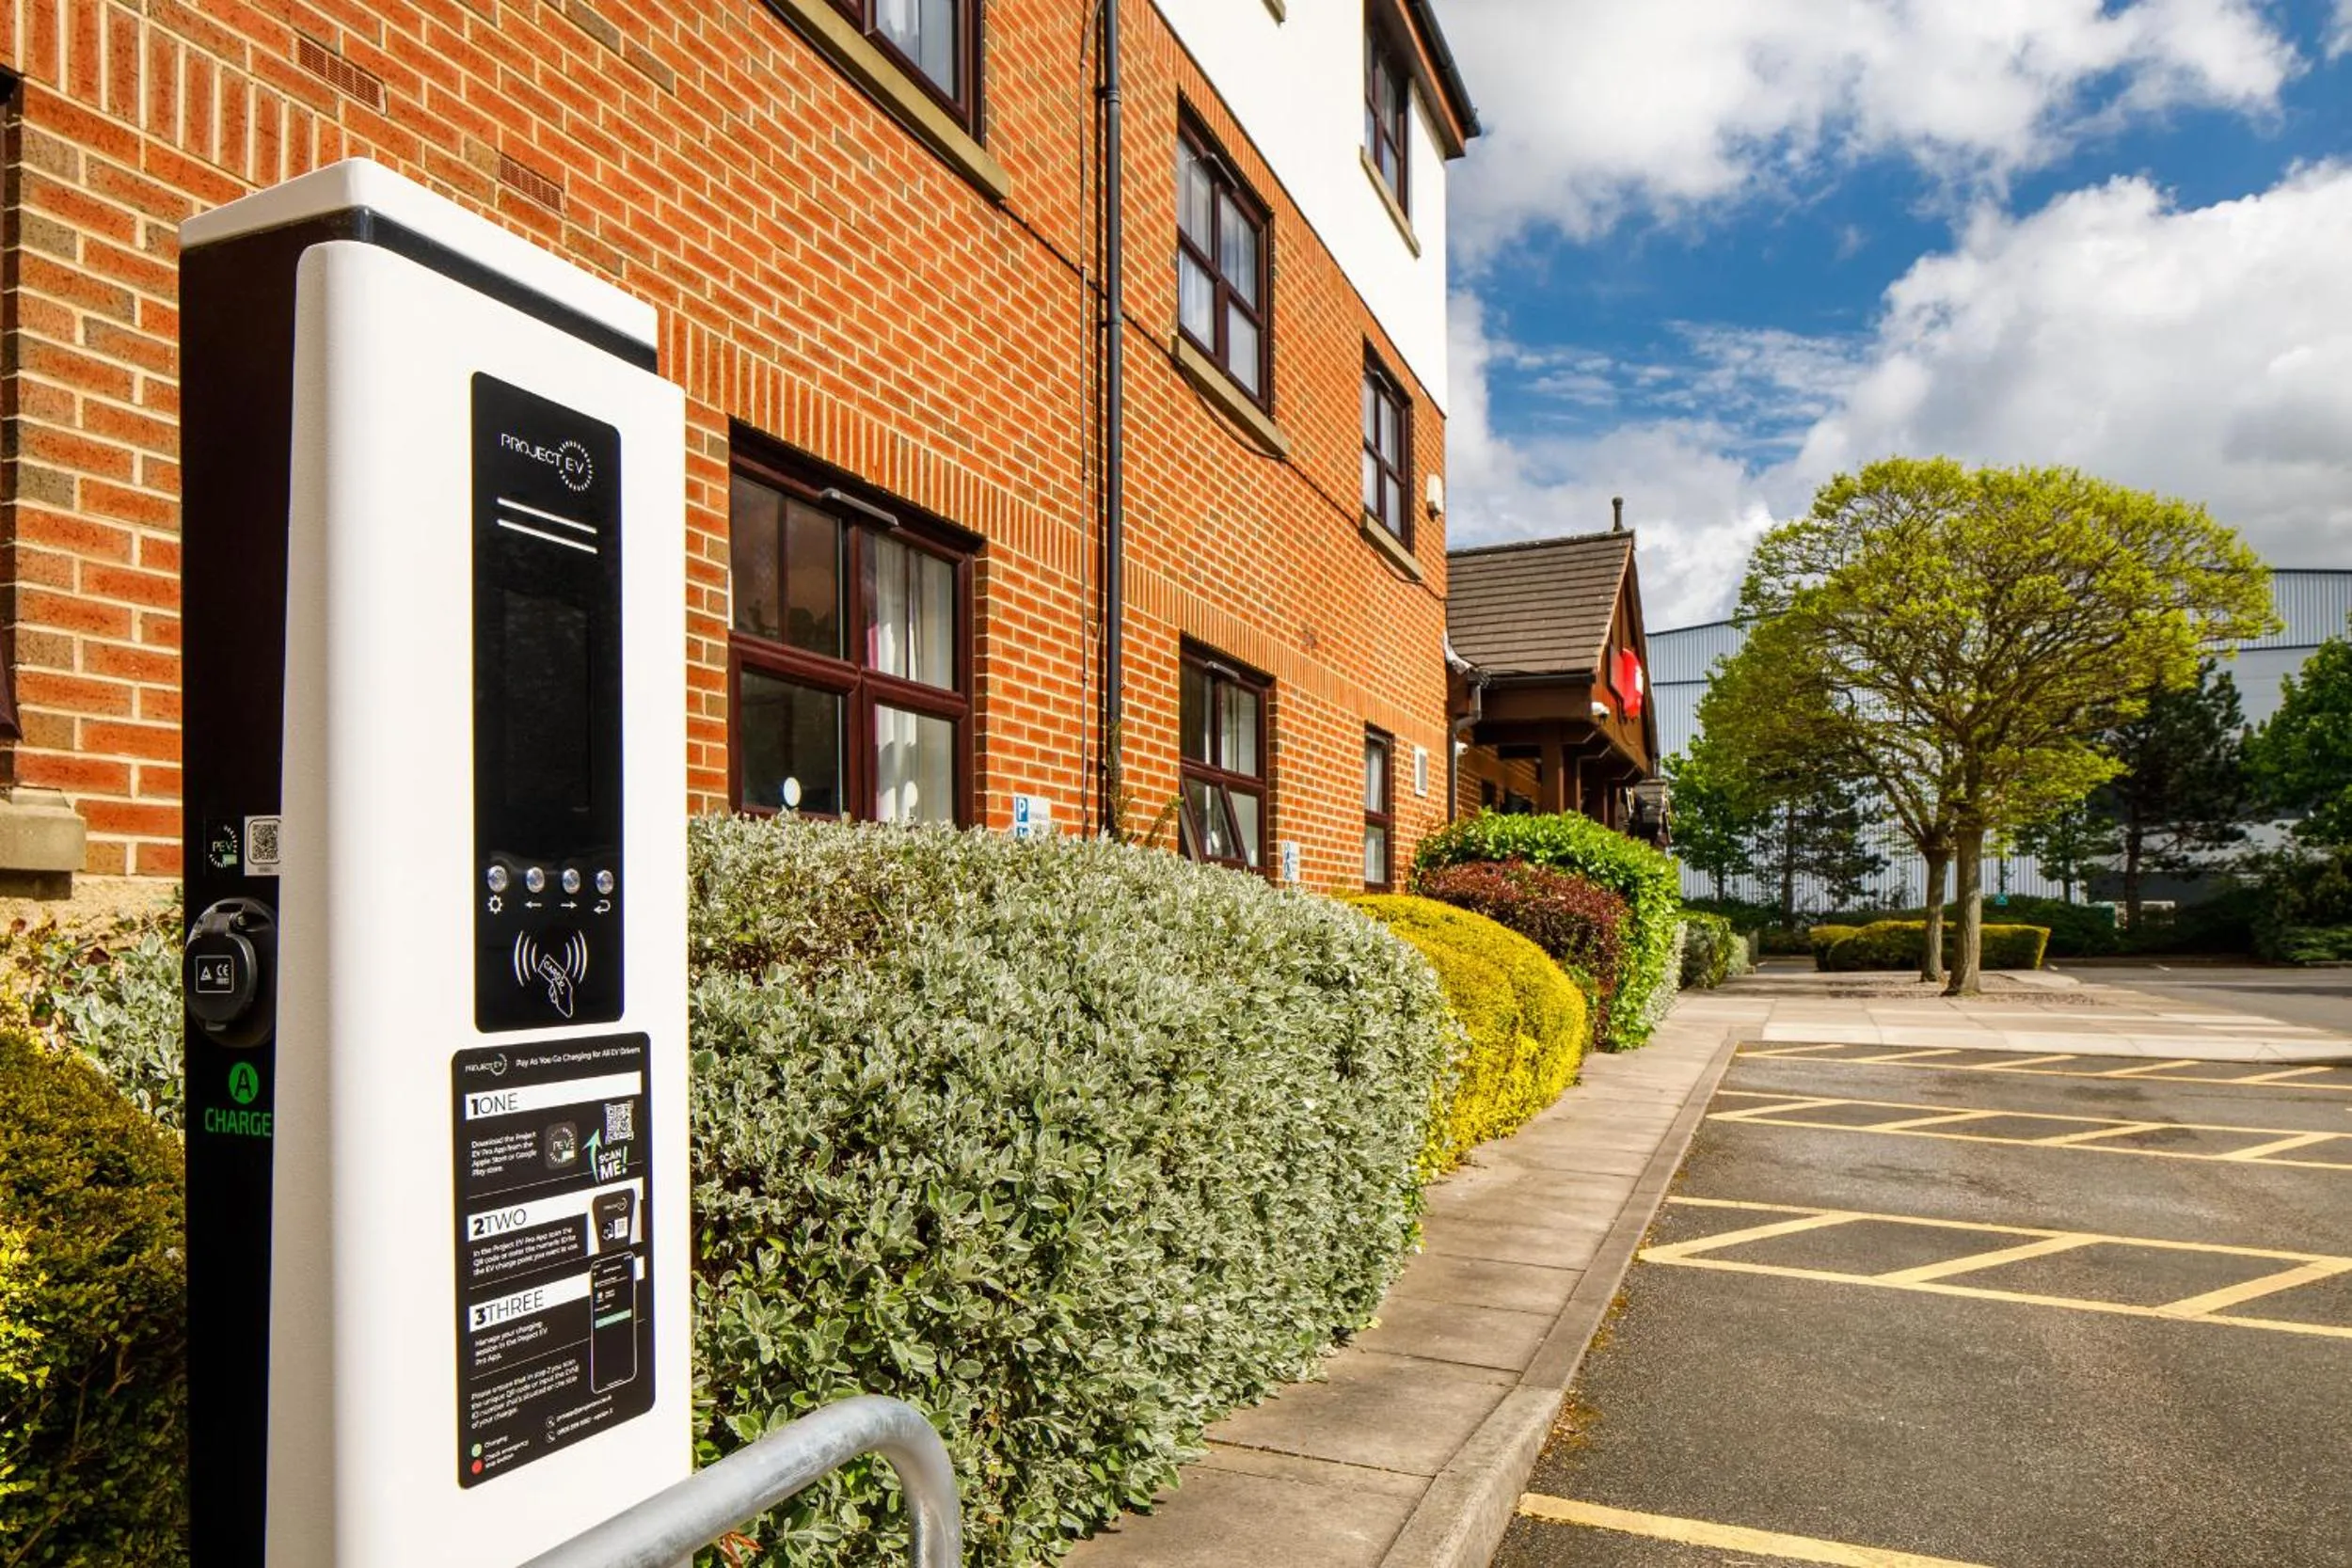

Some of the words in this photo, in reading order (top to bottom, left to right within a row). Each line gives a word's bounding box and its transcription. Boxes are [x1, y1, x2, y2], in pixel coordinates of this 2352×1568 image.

[501, 433, 563, 467] PROJECT
[564, 457, 584, 474] EV
[516, 1058, 528, 1069] Pay
[530, 1057, 539, 1066] As
[540, 1056, 551, 1065] You
[552, 1054, 562, 1063] Go
[563, 1052, 592, 1063] Charging
[593, 1050, 601, 1058] for
[602, 1049, 611, 1057] All
[234, 1068, 252, 1098] A
[204, 1107, 272, 1138] CHARGE
[598, 1148, 622, 1164] SCAN
[599, 1146, 628, 1180] ME!
